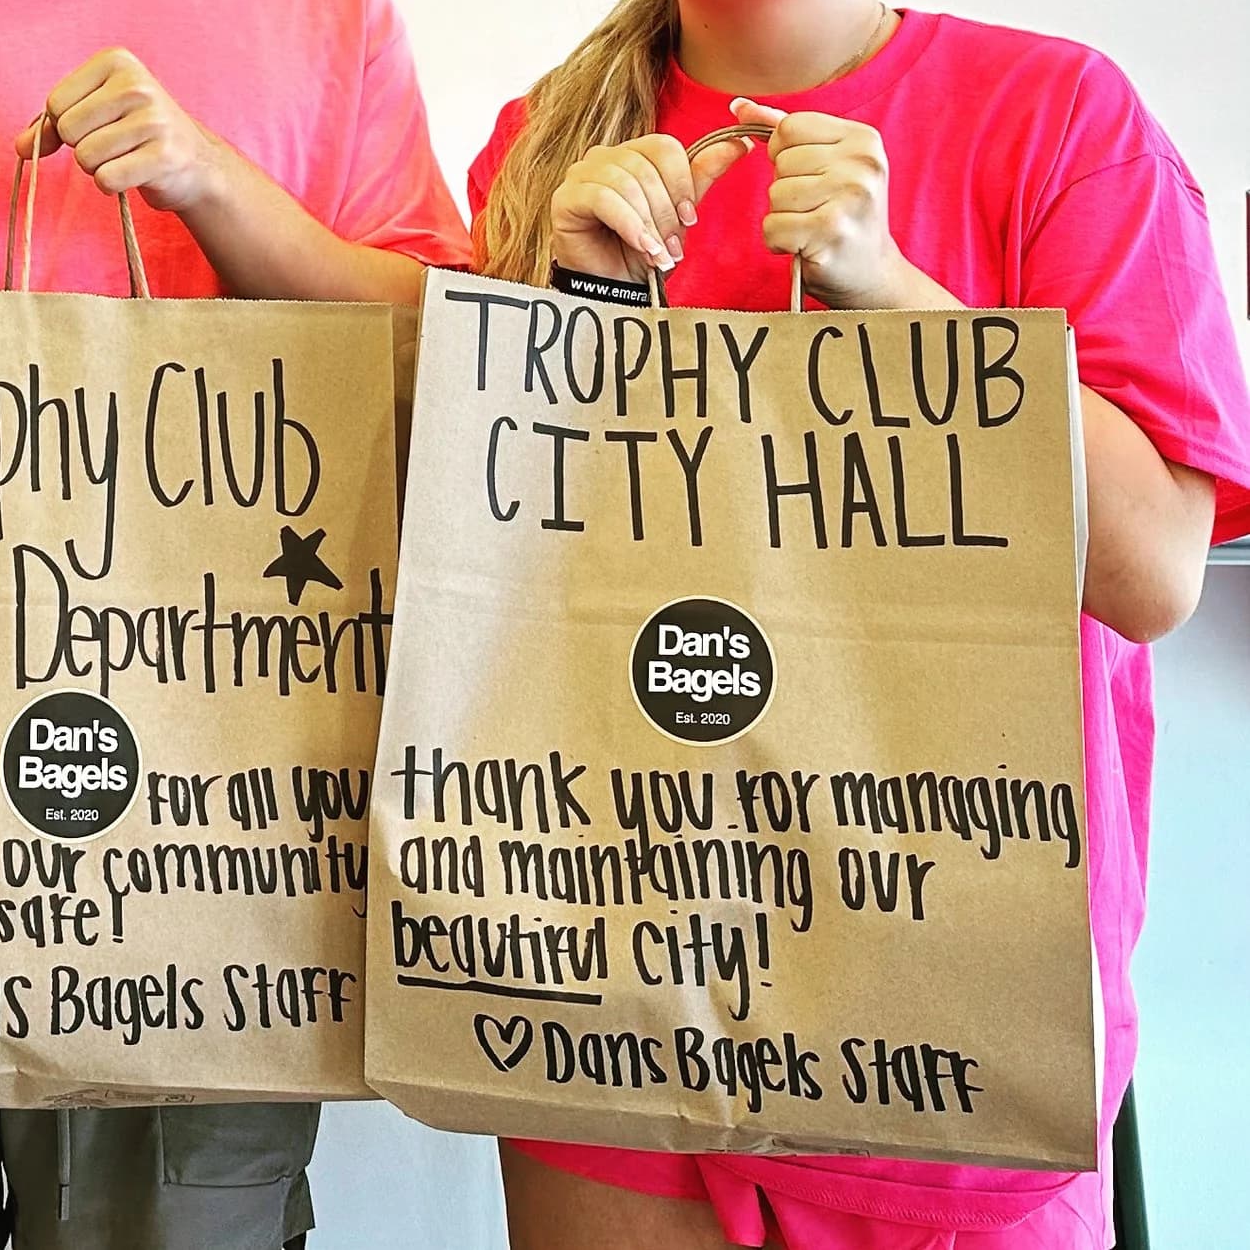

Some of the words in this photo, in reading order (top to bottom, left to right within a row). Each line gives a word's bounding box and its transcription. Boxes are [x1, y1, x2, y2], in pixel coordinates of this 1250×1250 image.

[571, 278, 649, 302] www.emera
[445, 290, 769, 424] TROPHY
[807, 317, 1025, 428] CLUB
[145, 358, 321, 516] Club
[486, 416, 714, 547] CITY
[762, 431, 1008, 549] HALL
[12, 543, 393, 697] Department
[658, 624, 751, 659] Dan's
[648, 661, 761, 702] Bagels
[676, 712, 697, 724] Est.
[700, 713, 730, 725] 2020
[29, 718, 118, 753] Dan's
[18, 755, 128, 798] Bagels
[46, 808, 67, 820] Est.
[70, 808, 99, 821] 2020
[226, 771, 279, 830] all
[292, 765, 368, 842] you
[391, 745, 591, 833] thank
[611, 767, 713, 850] you
[829, 764, 1082, 868] managing
[3, 839, 86, 893] our
[102, 835, 367, 917] community
[400, 835, 485, 898] and
[500, 833, 814, 933] maintaining
[839, 847, 936, 921] our
[391, 900, 609, 985] beautiful
[49, 964, 204, 1045] Bagels
[541, 1020, 668, 1090] Dans
[672, 1025, 823, 1115] Bagels
